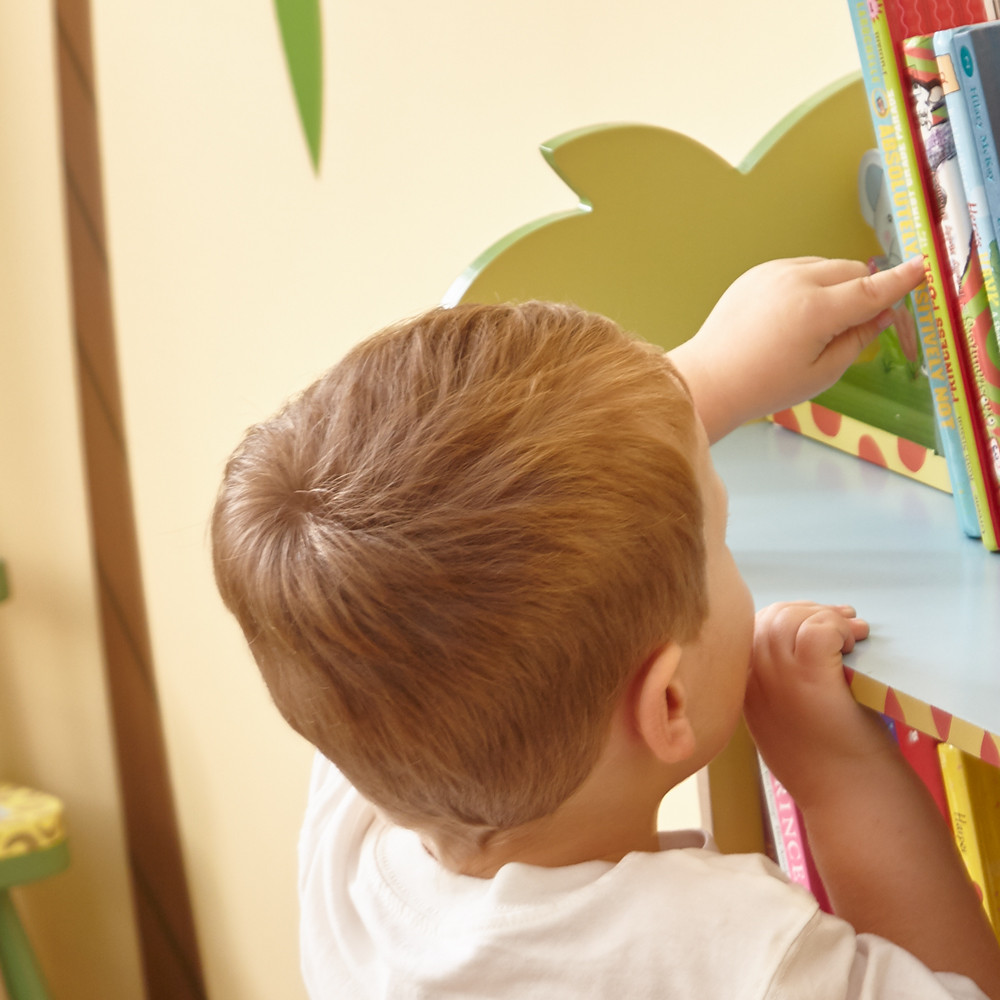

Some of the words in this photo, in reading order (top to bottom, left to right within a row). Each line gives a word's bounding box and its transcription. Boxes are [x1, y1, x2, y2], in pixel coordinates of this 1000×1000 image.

[970, 87, 982, 128] Hilary
[980, 135, 994, 181] McKay
[979, 251, 999, 308] HANK
[913, 281, 946, 381] SITIVELY
[934, 386, 955, 429] NOT
[773, 780, 806, 880] RINCE
